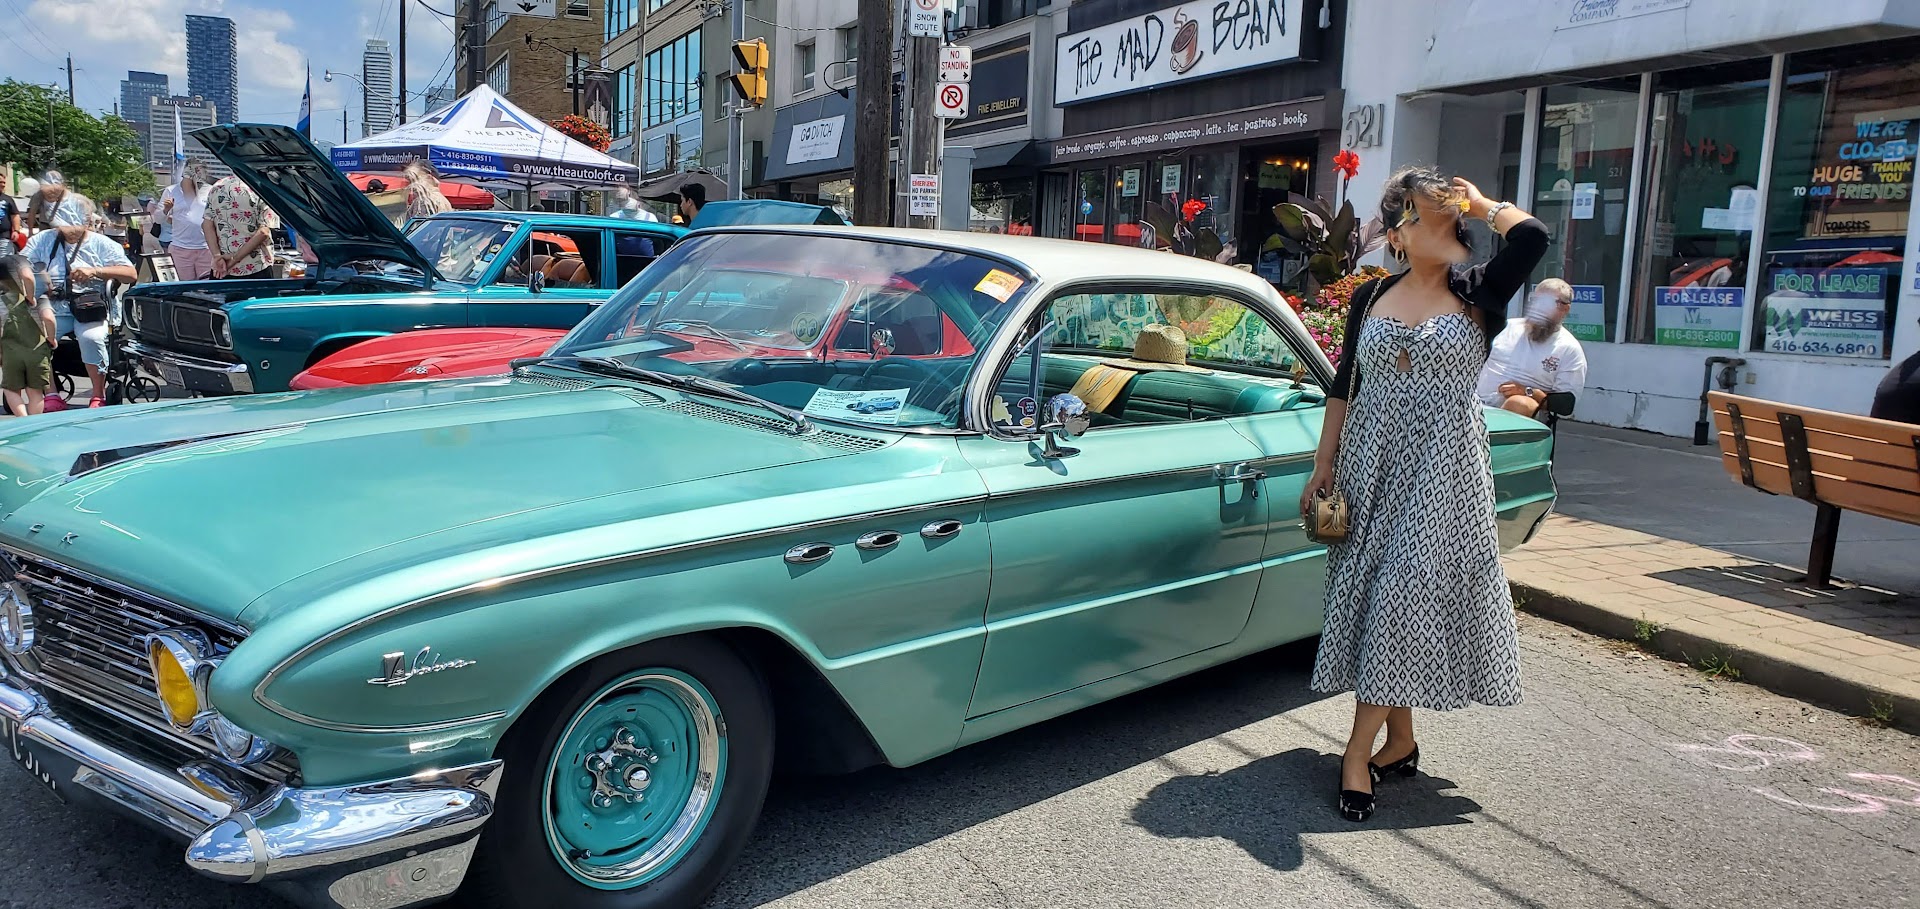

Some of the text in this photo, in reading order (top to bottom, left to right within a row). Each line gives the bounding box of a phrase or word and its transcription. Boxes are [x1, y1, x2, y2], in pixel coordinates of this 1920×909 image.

[916, 13, 937, 22] SNOW
[1569, 7, 1615, 23] COMPANY
[914, 23, 938, 32] ROUTE
[1114, 14, 1163, 81] MAD
[950, 50, 960, 59] NO
[941, 61, 969, 70] STANDING
[978, 97, 1021, 114] FINE JEWELLERY
[1345, 103, 1385, 149] 521
[801, 127, 811, 141] GO
[1055, 109, 1308, 158] fair trade organic coffee espresso cappuccino latte tea pastries books
[447, 152, 492, 162] 416-830-0511
[522, 163, 626, 182] www.theautoloft.ca
[1609, 167, 1623, 177] 521
[1872, 162, 1912, 172] THANK
[1812, 165, 1863, 183] HUGE
[1879, 172, 1902, 183] YOU
[1793, 183, 1907, 200] TO OUR FRIENDS
[1774, 273, 1881, 293] FOR LEASE
[1575, 290, 1597, 301] ASE
[1664, 292, 1734, 304] FOR LEASE
[1808, 310, 1878, 324] WEISS
[1664, 329, 1734, 342] 416-636-6800
